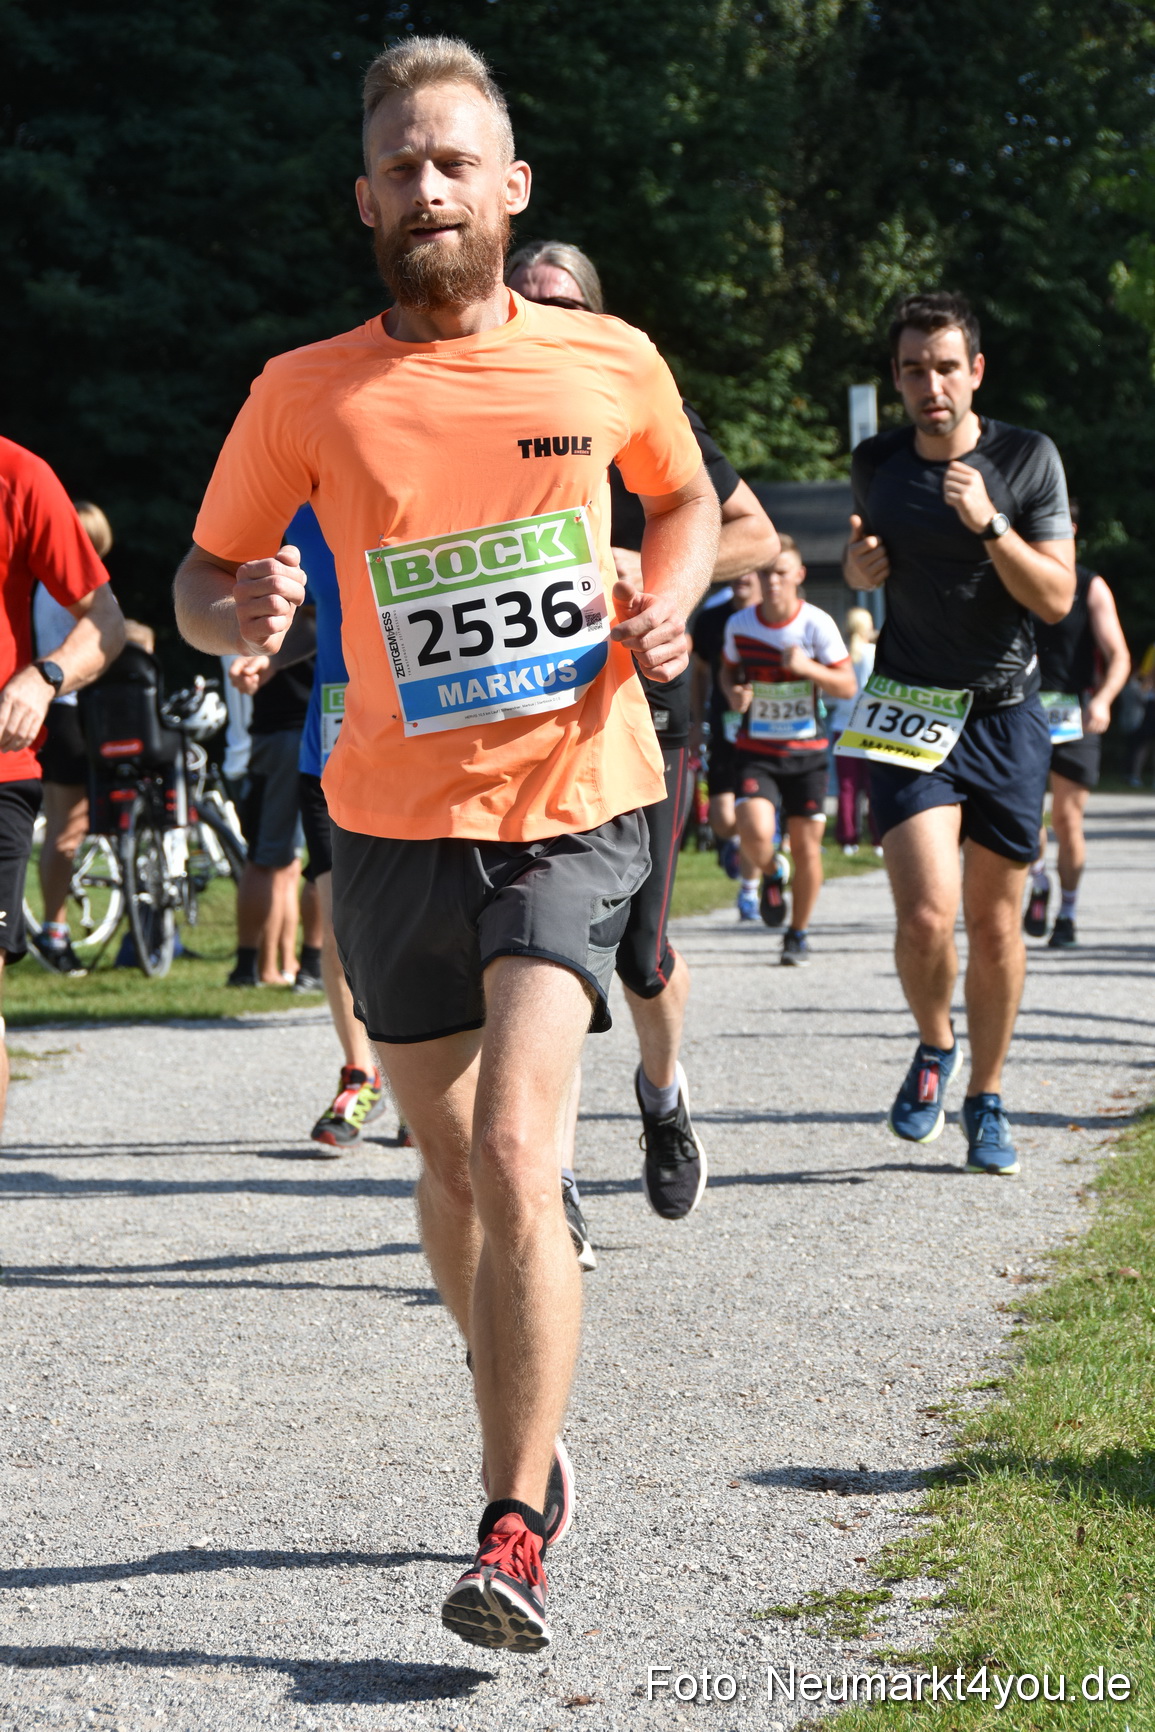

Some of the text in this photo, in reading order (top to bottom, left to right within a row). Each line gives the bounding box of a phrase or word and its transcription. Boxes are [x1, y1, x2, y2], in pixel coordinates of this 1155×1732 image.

[517, 435, 592, 459] THULE
[387, 523, 574, 593] BOCK
[581, 581, 592, 591] D
[407, 581, 583, 667] 2536
[437, 658, 578, 707] MARKUS
[873, 676, 957, 712] BOCK
[758, 701, 807, 719] 2326
[866, 702, 949, 744] 1305
